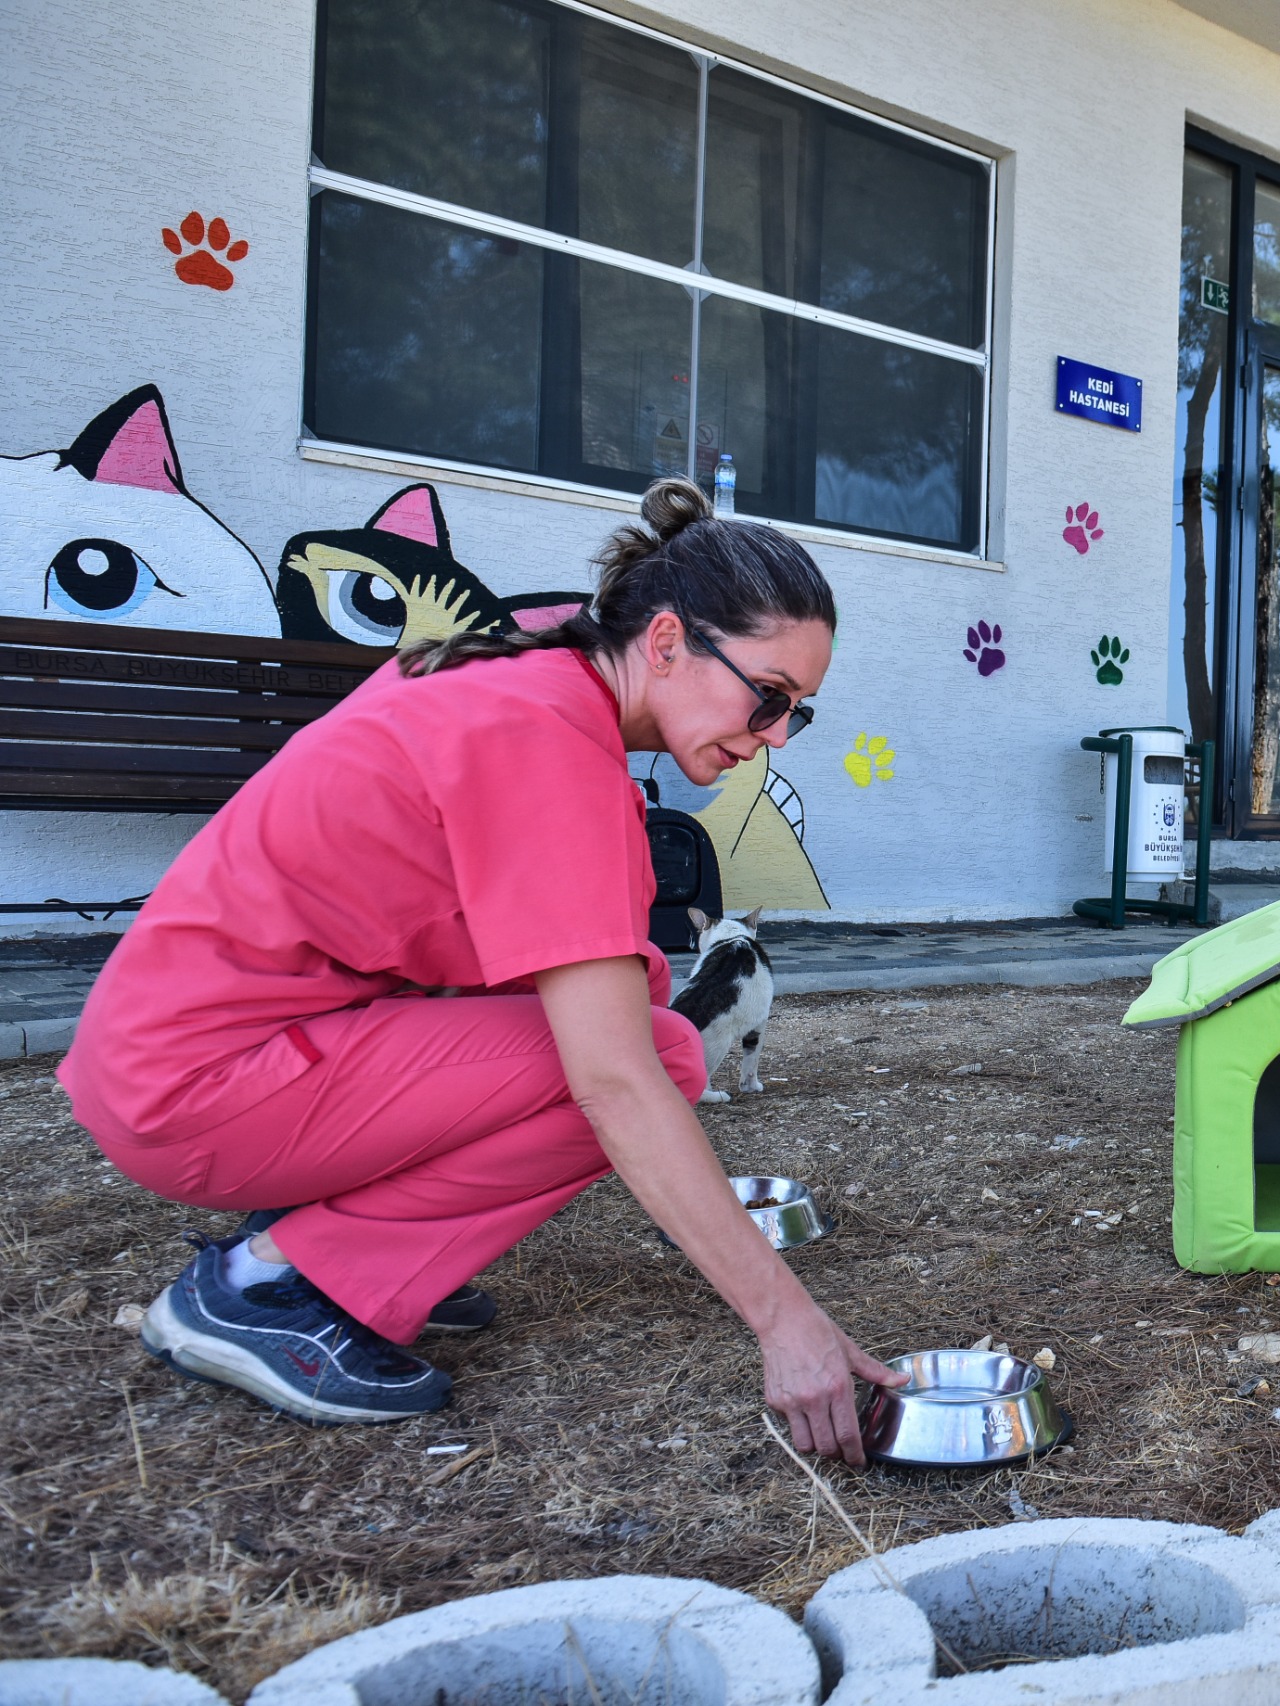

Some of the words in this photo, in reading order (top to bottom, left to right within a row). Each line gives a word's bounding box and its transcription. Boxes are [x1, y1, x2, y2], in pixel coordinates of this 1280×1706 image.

[1088, 377, 1114, 396] KEDİ
[1069, 389, 1130, 418] HASTANESİ
[14, 651, 108, 674] BURSA
